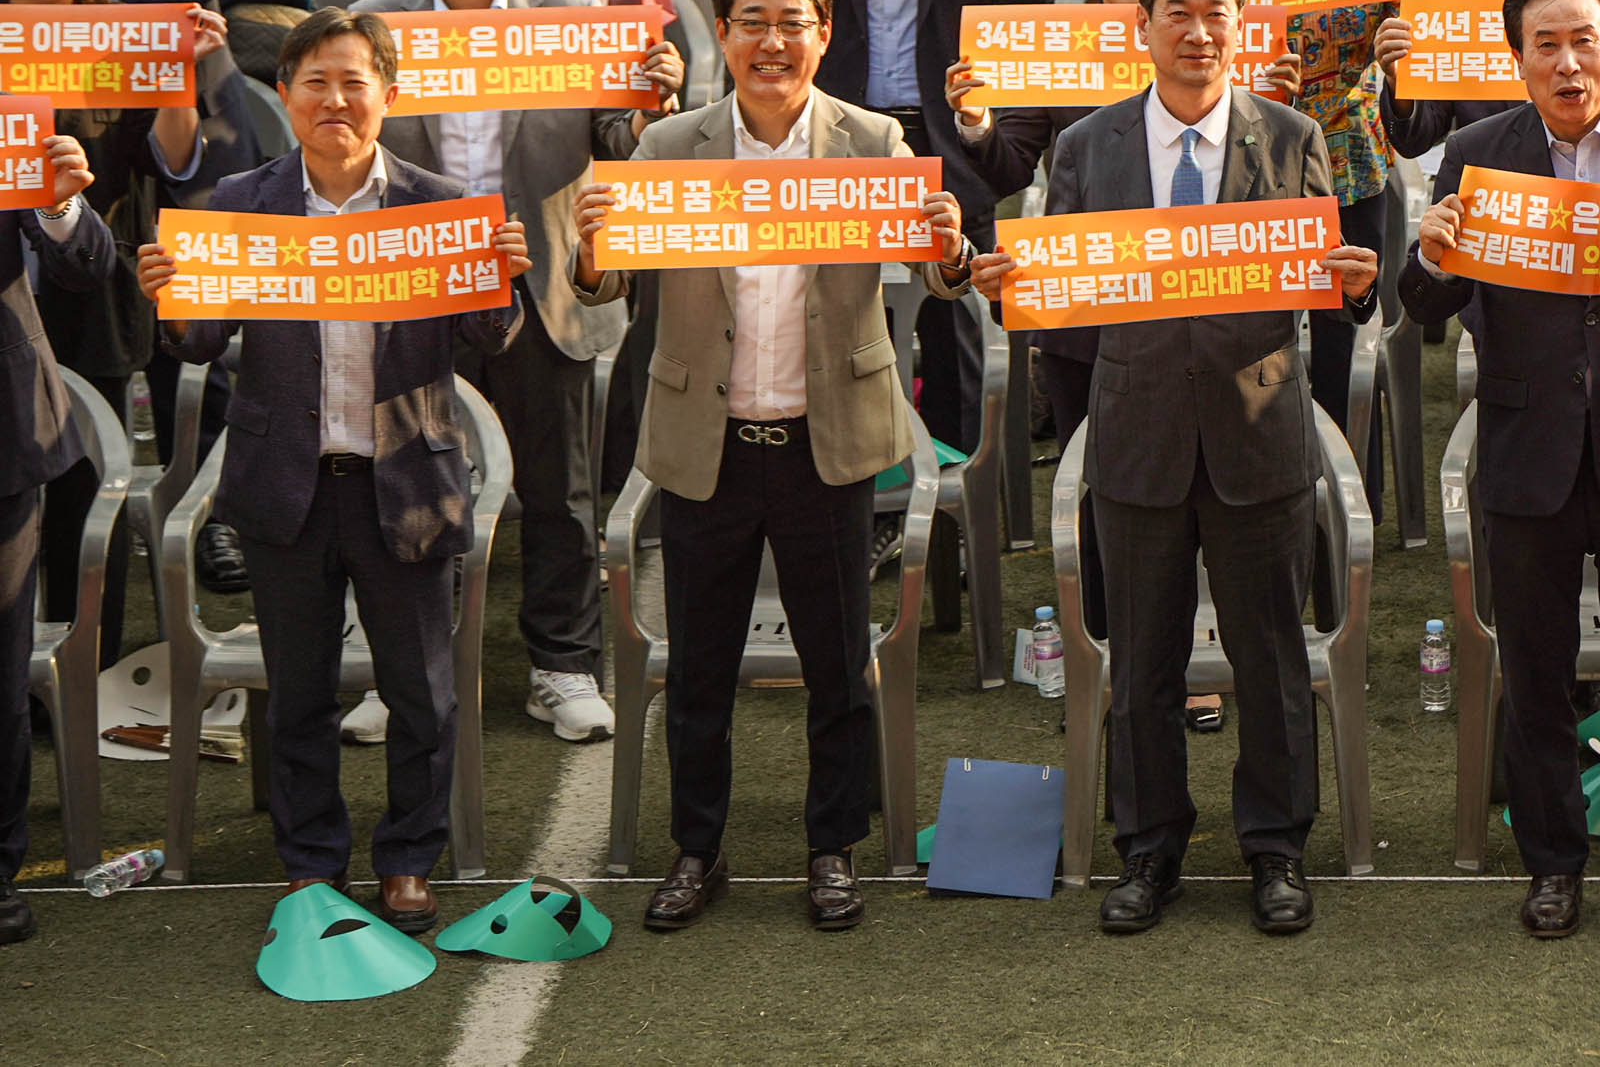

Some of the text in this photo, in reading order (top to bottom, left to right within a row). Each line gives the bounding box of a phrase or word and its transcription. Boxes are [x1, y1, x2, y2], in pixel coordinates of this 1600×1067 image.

[36, 21, 182, 53] 이루어진다
[129, 61, 186, 92] 신설
[608, 180, 674, 214] 34년
[779, 176, 929, 212] 이루어진다
[1470, 188, 1523, 224] 34년
[174, 231, 239, 266] 34년
[346, 216, 493, 263] 이루어진다
[607, 219, 933, 255] 국립목포대 의과대학 신설
[1015, 233, 1078, 268] 34년
[1180, 216, 1327, 258] 이루어진다
[1457, 228, 1575, 275] 국립목포대
[170, 258, 500, 305] 국립목포대 의과대학 신설
[1014, 258, 1335, 311] 국립목포대 의과대학 신설
